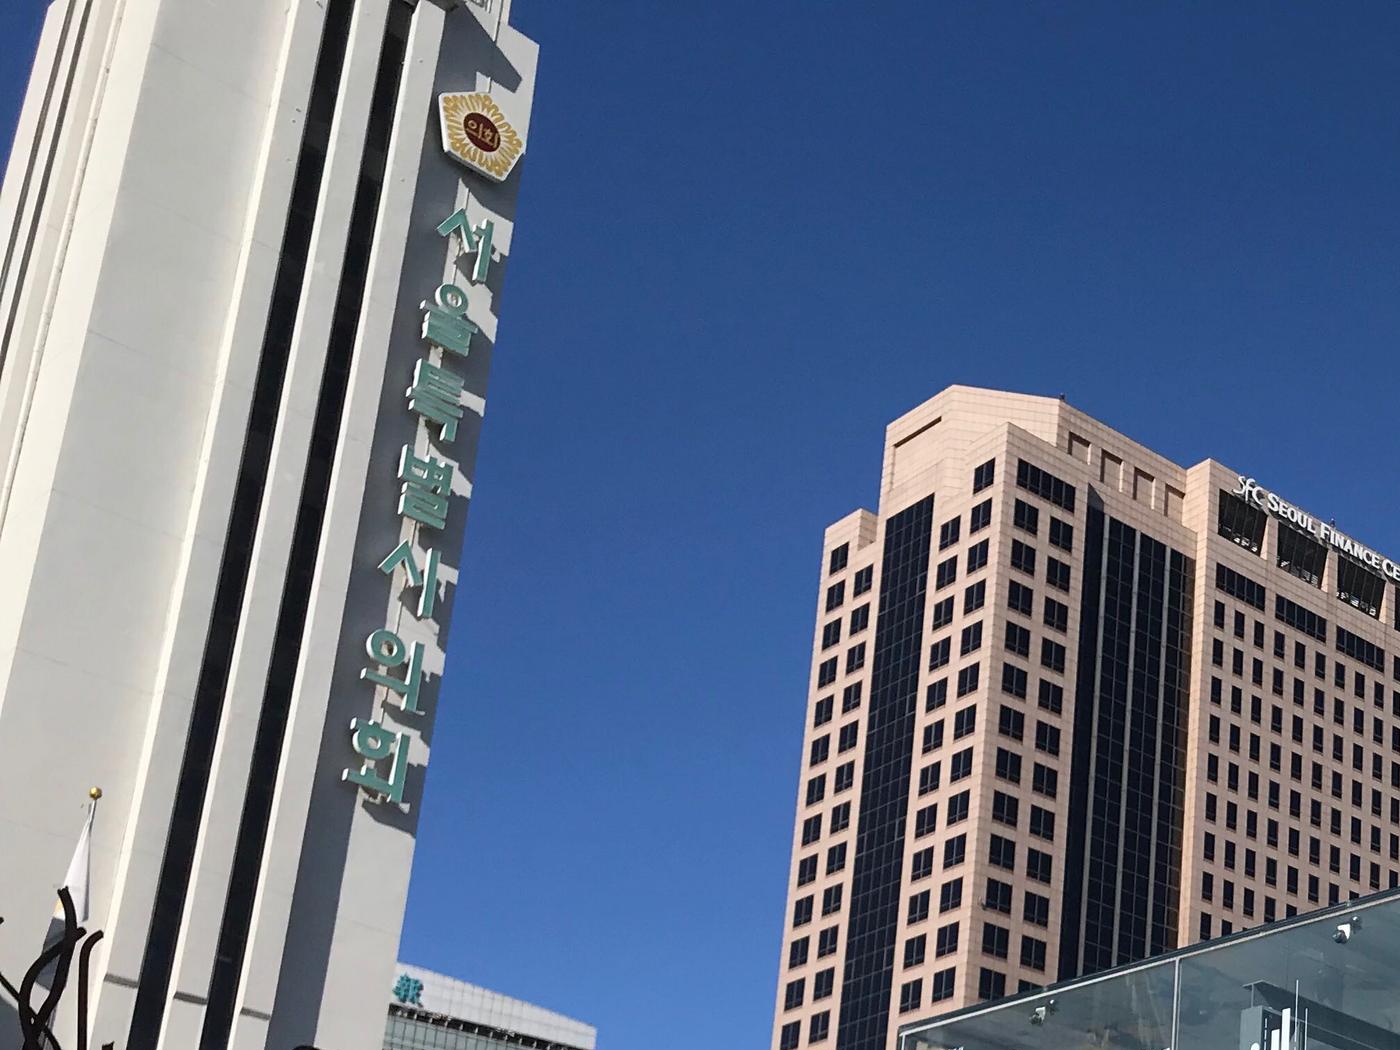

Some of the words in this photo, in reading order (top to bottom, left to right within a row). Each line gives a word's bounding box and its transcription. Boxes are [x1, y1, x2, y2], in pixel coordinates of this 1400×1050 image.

[468, 117, 499, 150] 의회
[342, 207, 494, 803] 서울특별시의회
[1267, 493, 1316, 534] SEOUL
[1320, 522, 1382, 569] FINANCE
